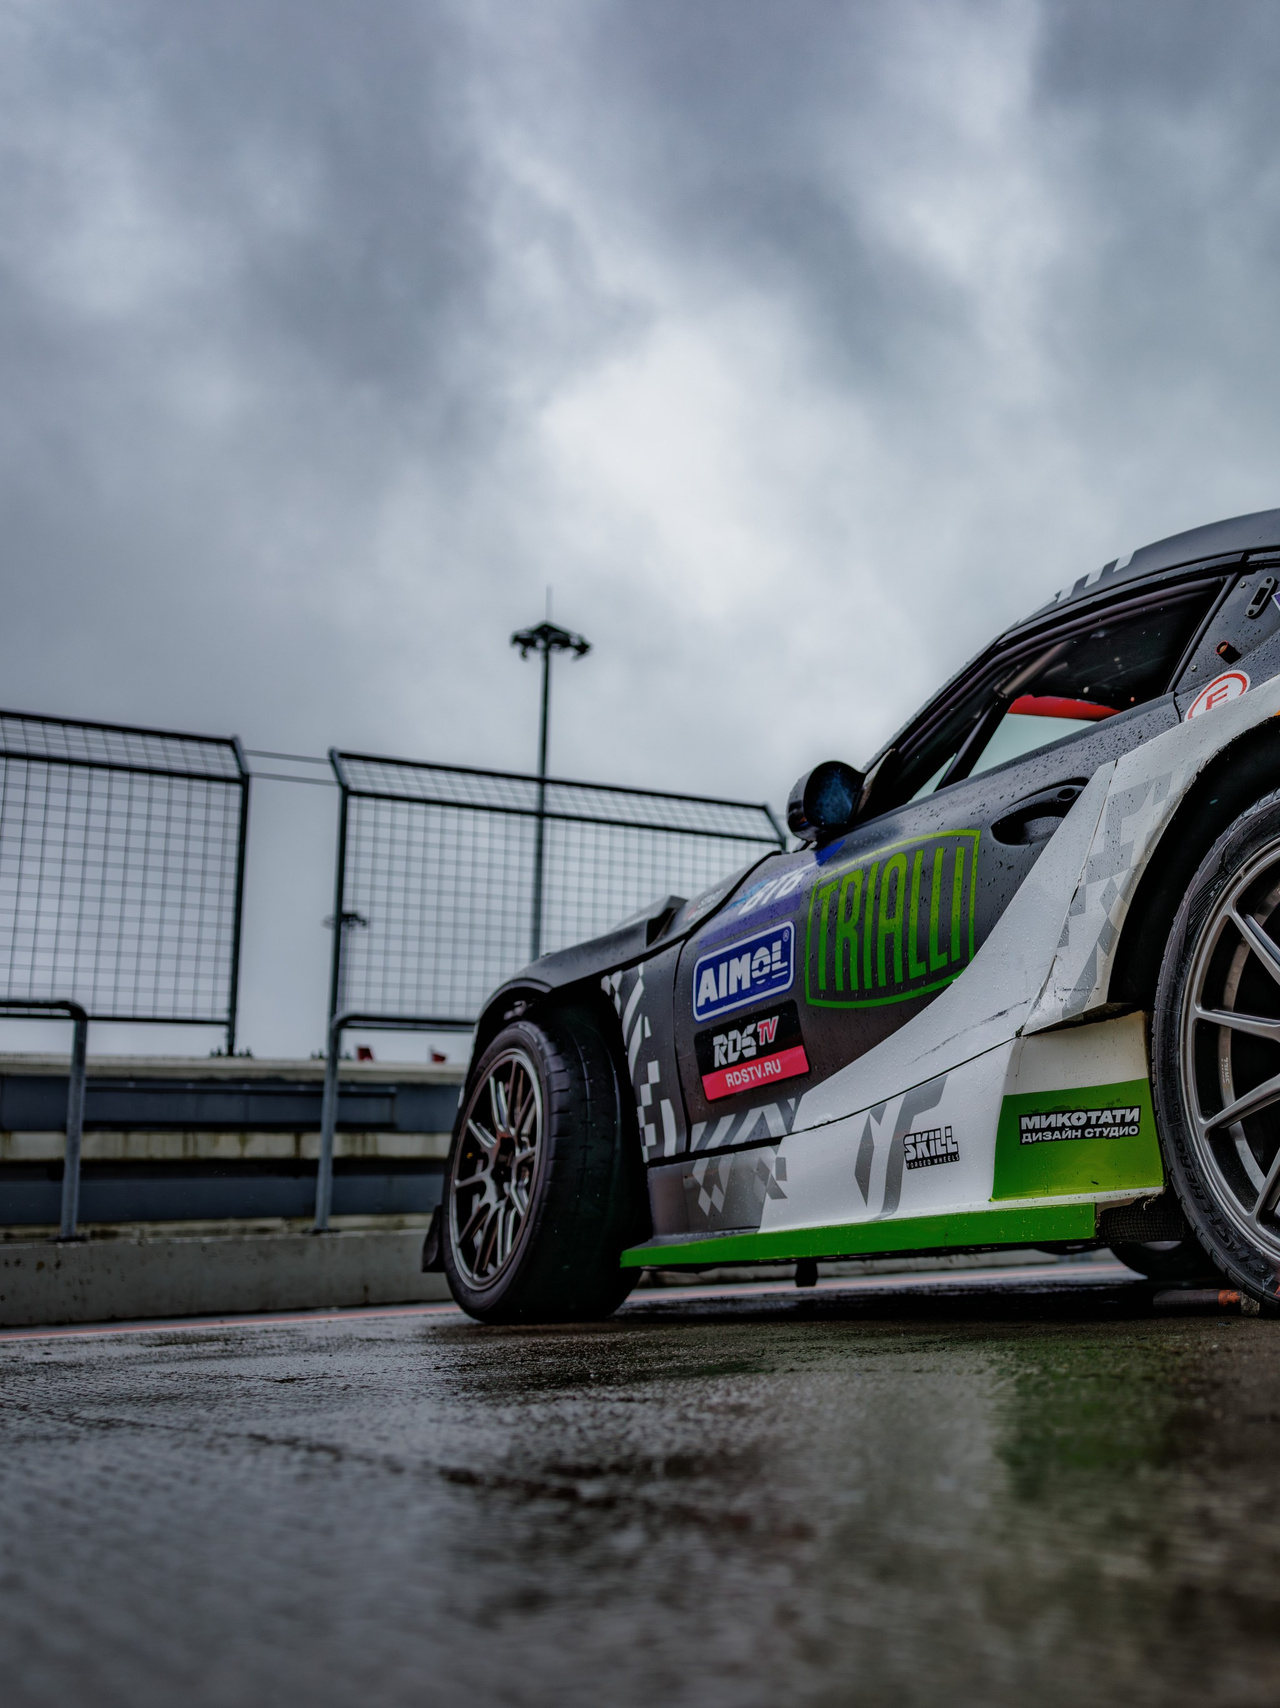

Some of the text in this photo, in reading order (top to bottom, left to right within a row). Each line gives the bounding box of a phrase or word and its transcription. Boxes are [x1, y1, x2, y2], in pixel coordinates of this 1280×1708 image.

[818, 846, 965, 992] TRIALLI
[696, 939, 789, 1008] AIMOL
[712, 1015, 779, 1068] RDS TV
[725, 1058, 782, 1088] RDSTV.RU
[1020, 1107, 1140, 1130] МИКОТАТИ
[1021, 1125, 1139, 1144] ДИЗАЙН СТУДИО
[903, 1125, 959, 1162] SKILL
